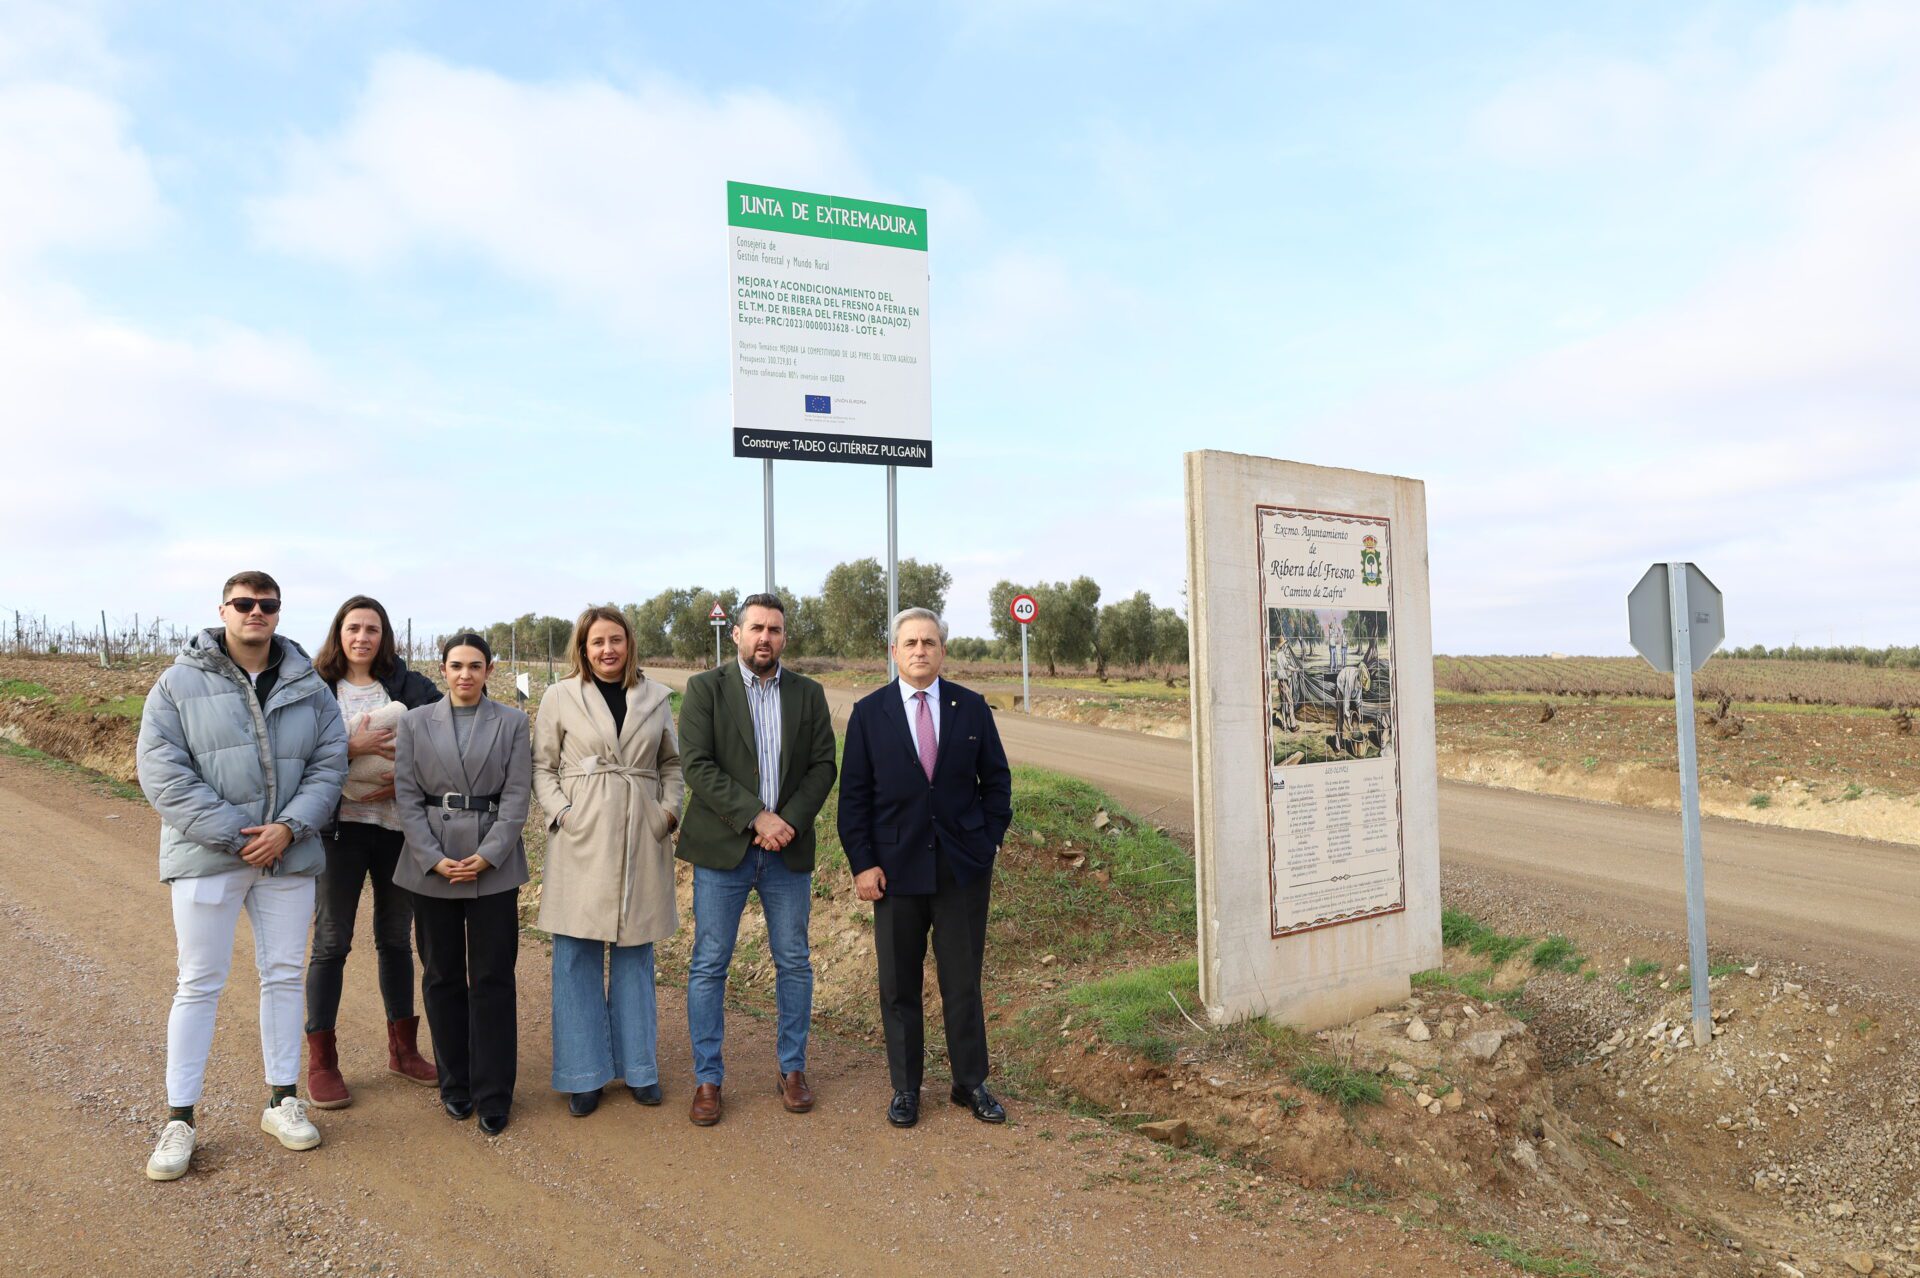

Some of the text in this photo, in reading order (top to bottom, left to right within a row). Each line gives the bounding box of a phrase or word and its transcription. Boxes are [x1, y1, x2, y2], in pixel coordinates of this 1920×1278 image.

[740, 195, 917, 235] JUNTA DE EXTREMADURA
[769, 239, 776, 251] de
[737, 250, 759, 262] Gestión
[762, 252, 784, 265] Forestal
[794, 257, 812, 269] Mundo
[815, 259, 830, 271] Rural
[738, 275, 894, 302] MEJORA Y ACONDICIONAMIENTO DEL
[738, 288, 920, 317] CAMINO DE RIBERA DEL FRESNO A FERIA EN
[738, 301, 911, 329] EL T.M. DE RIBERA DEL FRESNO (BADAJOZ)
[738, 313, 764, 326] Expte:
[856, 325, 877, 336] LOTE
[879, 327, 886, 337] 4.
[780, 345, 798, 357] MEJORAR
[858, 352, 872, 360] PYMES
[882, 354, 896, 362] SECTOR
[742, 435, 926, 459] Construye: TADEO GUTIÉRREZ PULGARÍN
[1273, 523, 1349, 542] Excmo. Ayuntamiento
[1308, 542, 1317, 555] de
[1270, 558, 1355, 580] Ribera del Fresno
[1313, 586, 1321, 598] de
[1016, 604, 1033, 614] 40
